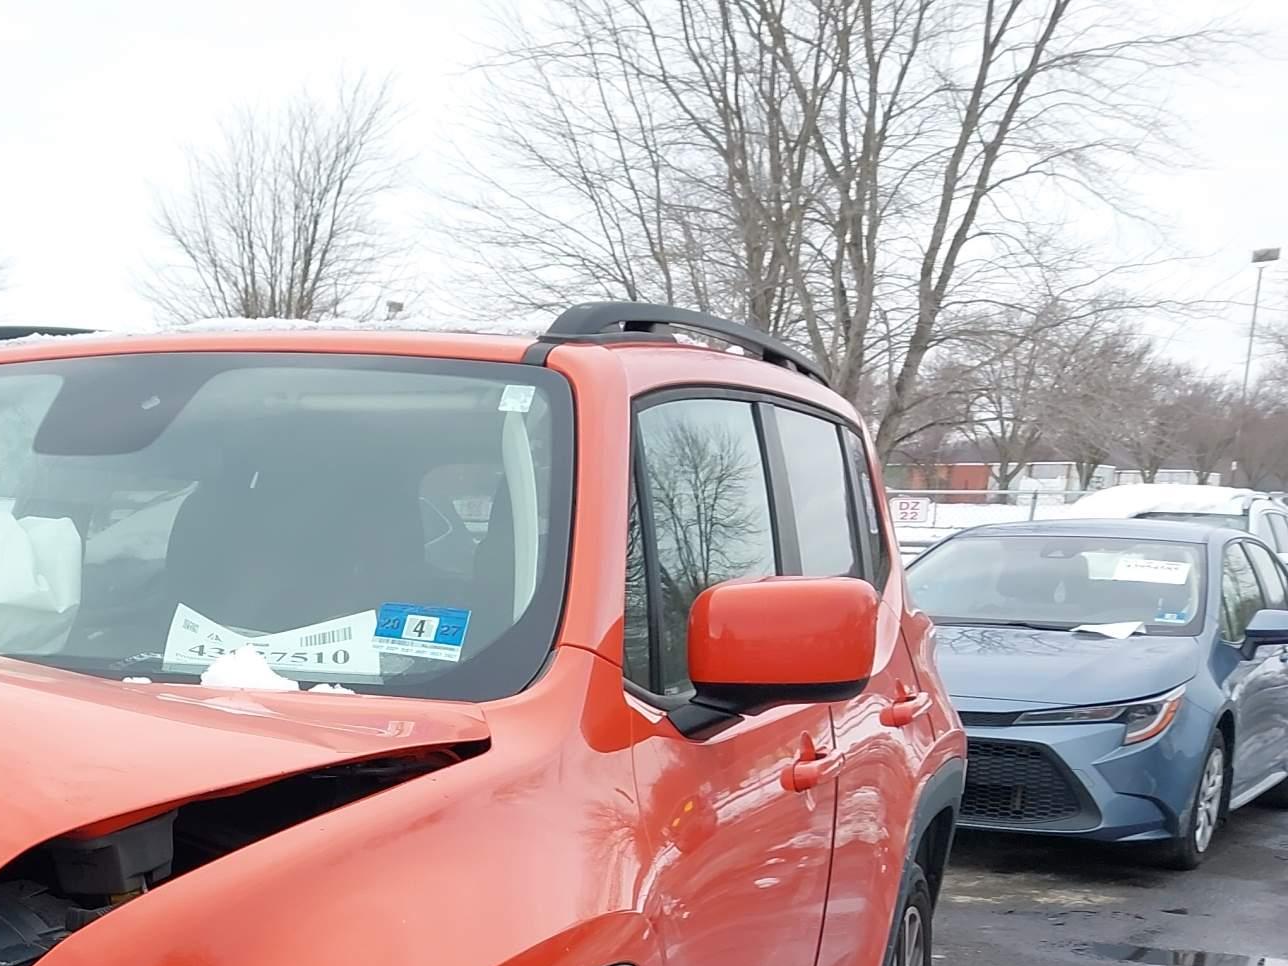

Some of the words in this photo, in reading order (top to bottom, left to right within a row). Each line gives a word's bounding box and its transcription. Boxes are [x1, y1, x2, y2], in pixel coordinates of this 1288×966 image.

[899, 501, 920, 511] DZ
[900, 511, 919, 520] 22
[412, 619, 427, 638] 4
[439, 624, 461, 637] 27
[188, 644, 351, 665] 437510
